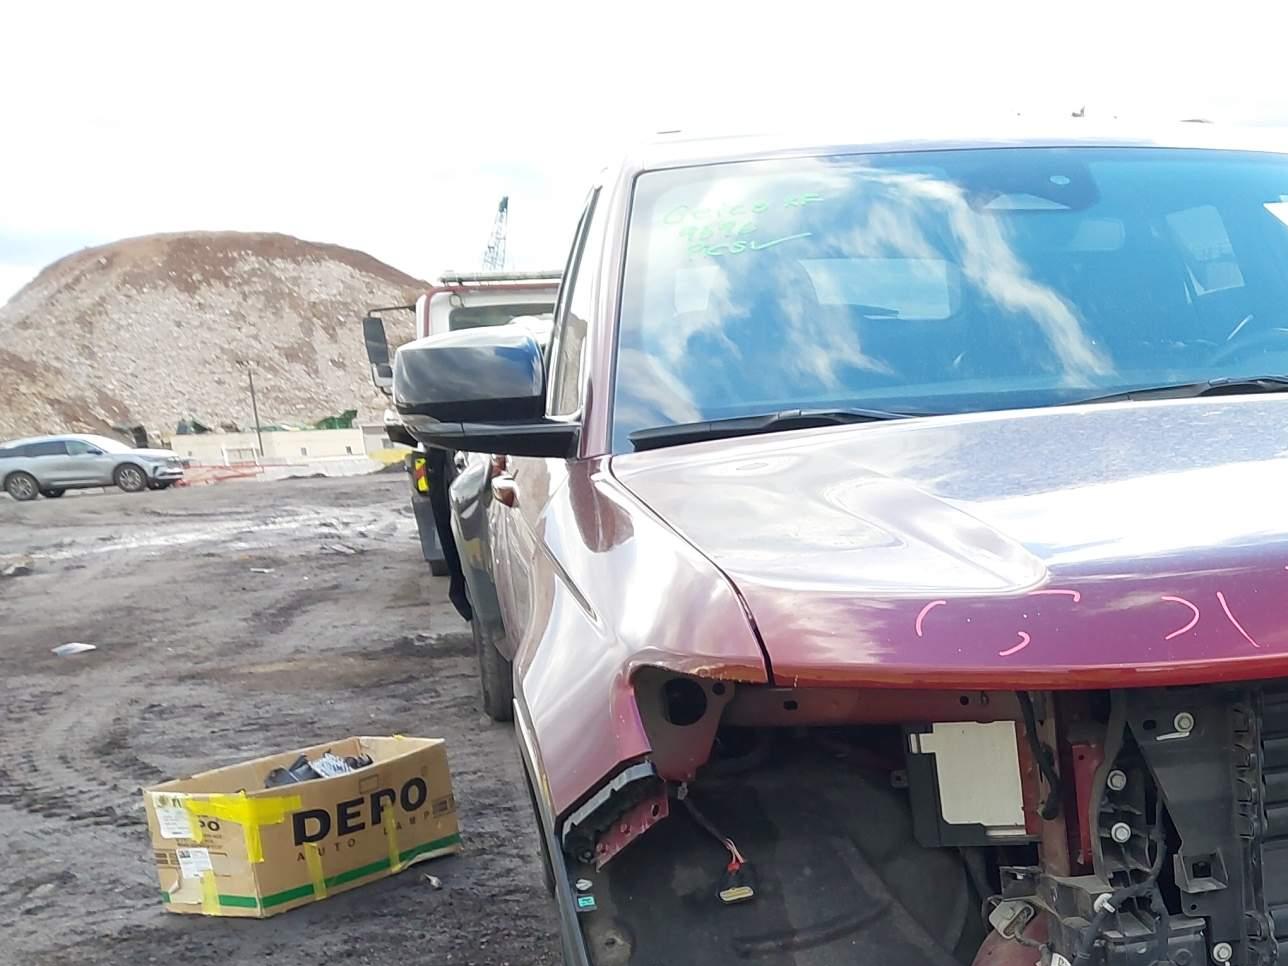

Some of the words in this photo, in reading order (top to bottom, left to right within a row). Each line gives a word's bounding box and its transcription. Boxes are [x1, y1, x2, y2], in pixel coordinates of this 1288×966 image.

[292, 777, 428, 847] DEPO
[296, 838, 356, 862] AUTO
[383, 810, 430, 836] LAMP
